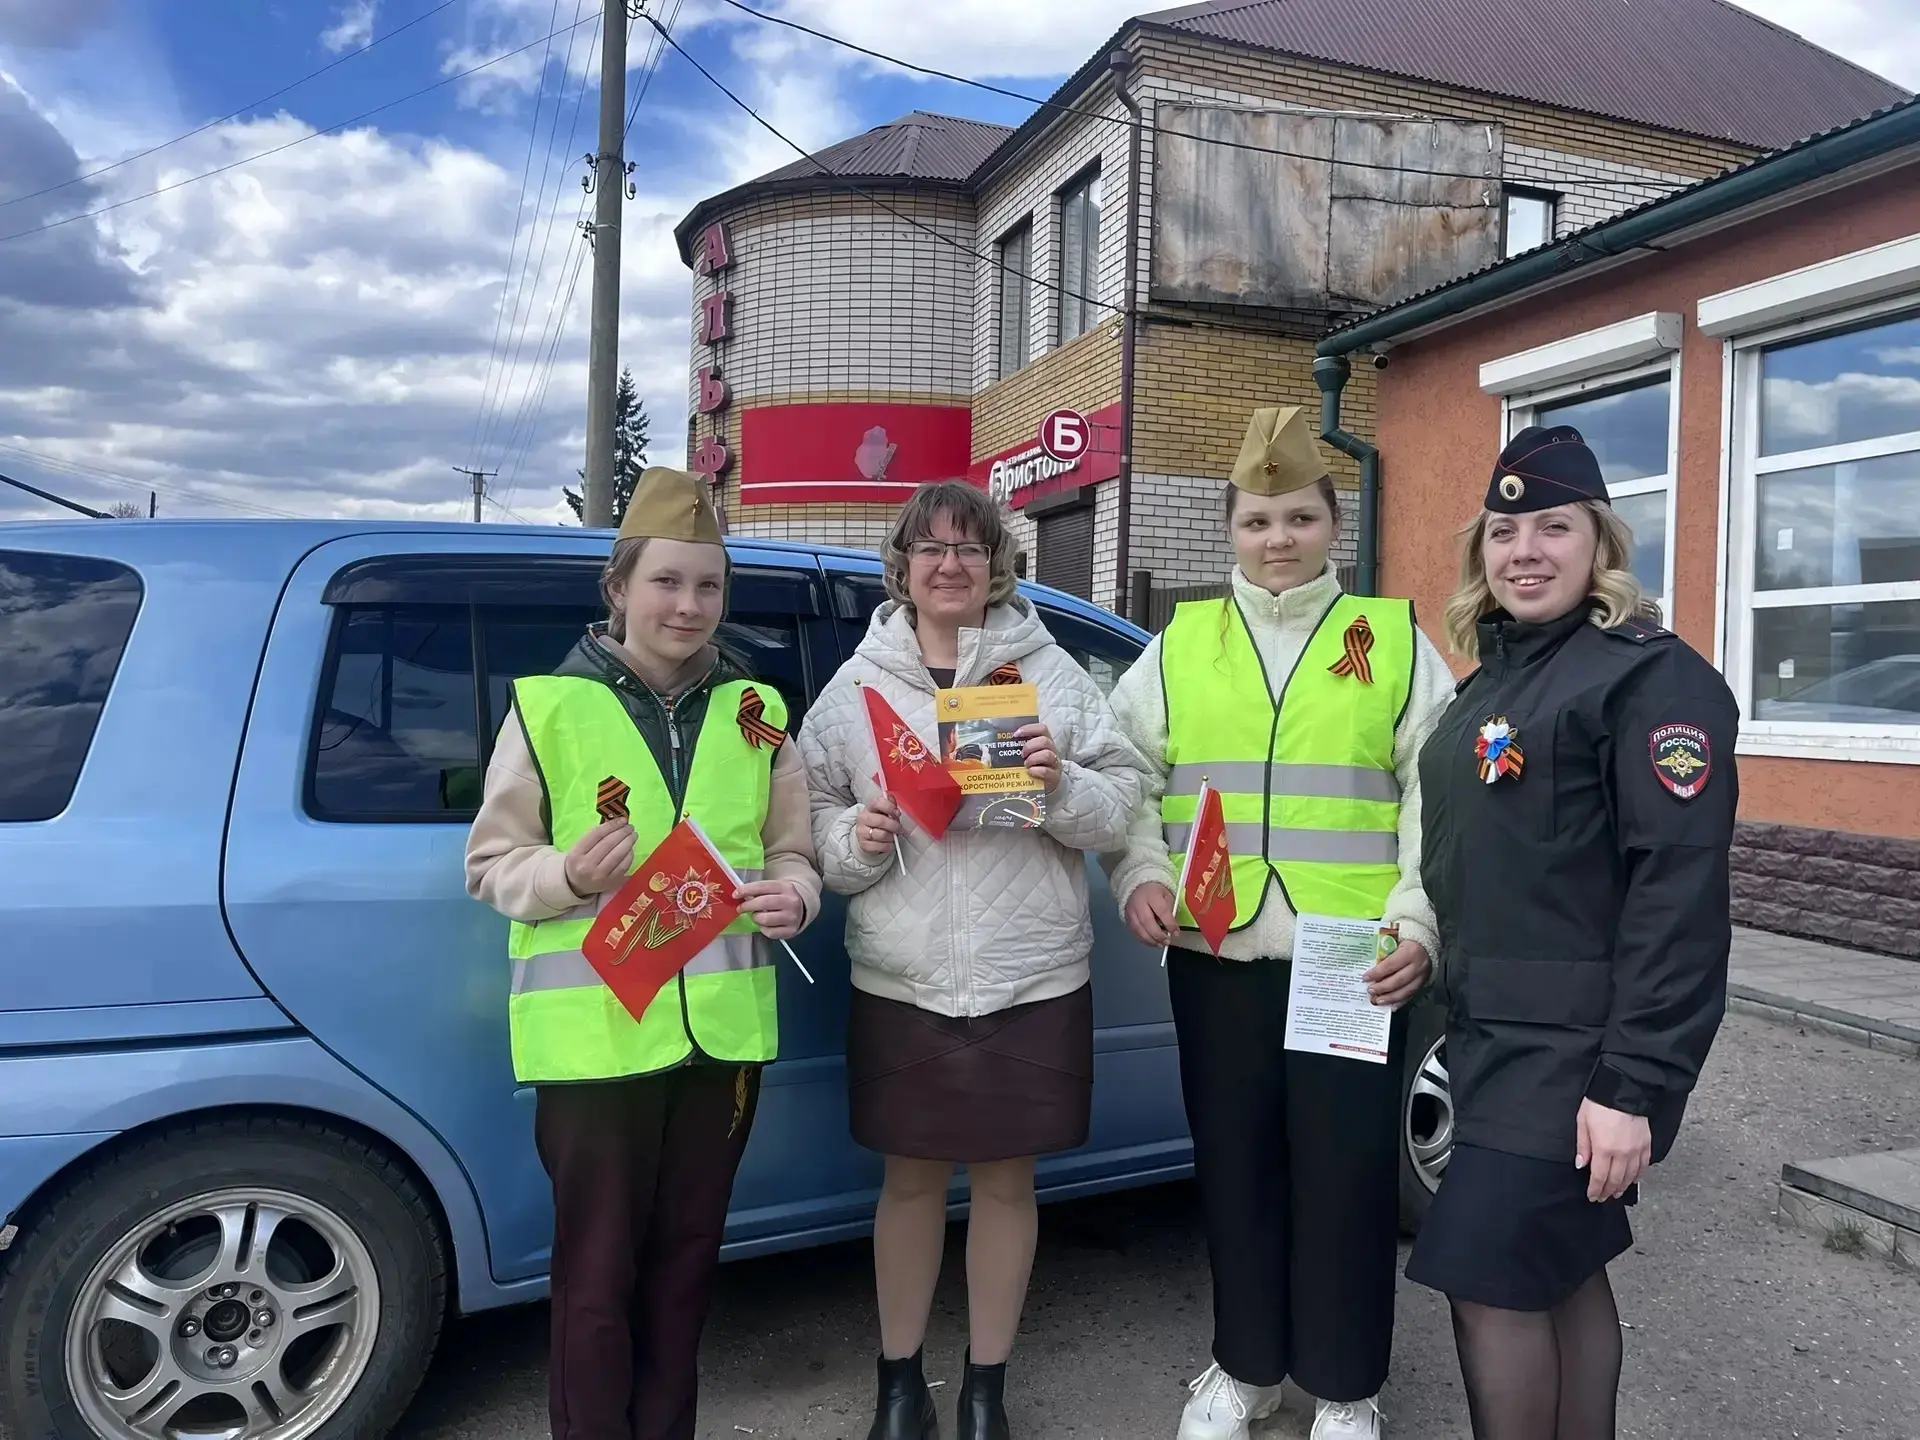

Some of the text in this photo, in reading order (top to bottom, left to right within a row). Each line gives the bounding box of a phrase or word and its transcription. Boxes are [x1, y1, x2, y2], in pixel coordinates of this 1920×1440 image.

[694, 222, 736, 535] АЛЬФ
[1053, 416, 1083, 452] Б
[997, 732, 1014, 740] ВОД
[1653, 726, 1706, 743] ПОЛИЦИЯ
[1660, 737, 1701, 752] РОССИЯ
[998, 749, 1022, 757] СКОРО
[966, 772, 1021, 782] СОБЛЮДАЙТЕ
[959, 780, 1035, 791] КОРОСТНОЙ РЕЖИМ
[1673, 783, 1695, 798] МВД
